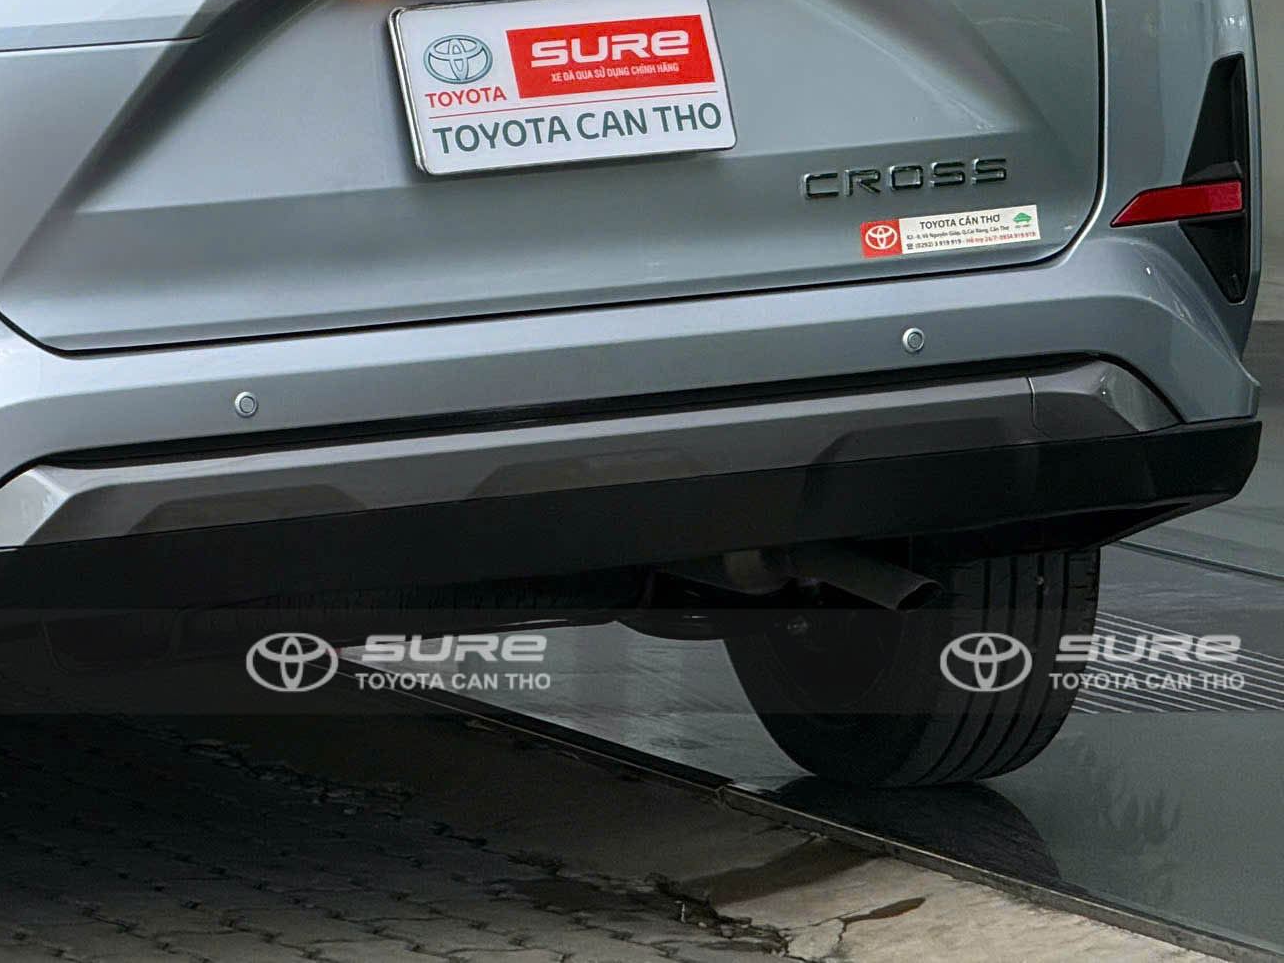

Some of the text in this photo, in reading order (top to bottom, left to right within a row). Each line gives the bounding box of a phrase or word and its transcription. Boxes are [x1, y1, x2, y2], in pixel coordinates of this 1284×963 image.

[550, 73, 563, 82] XE
[576, 69, 593, 80] QUA
[425, 86, 507, 108] TOYOTA
[432, 102, 722, 154] TOYOTA CAN THO
[802, 157, 1008, 200] CROSS
[920, 219, 957, 229] TOYOTA
